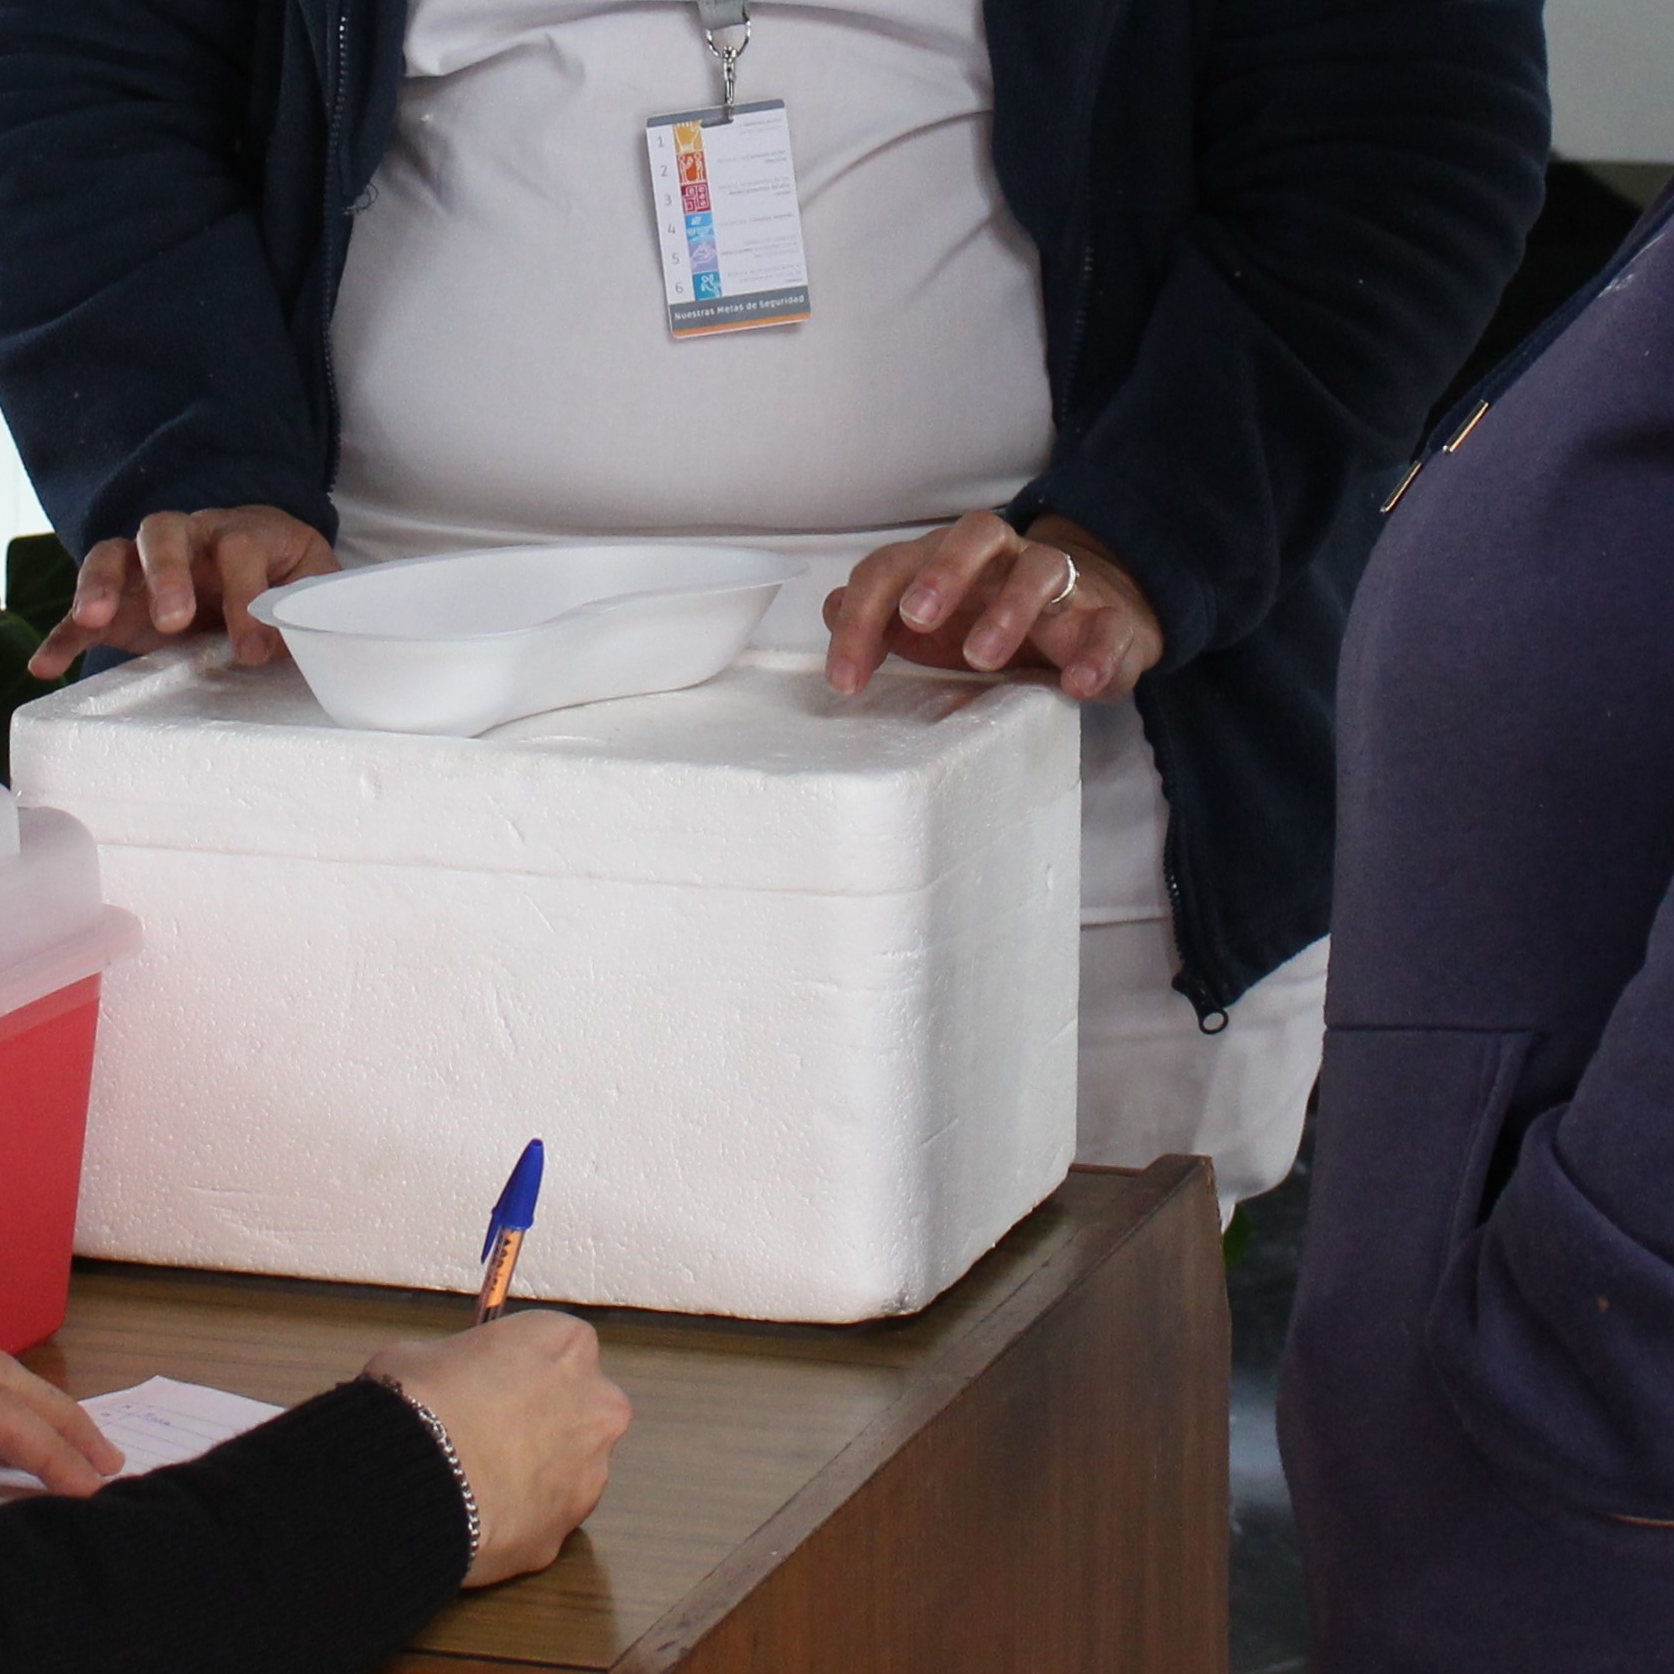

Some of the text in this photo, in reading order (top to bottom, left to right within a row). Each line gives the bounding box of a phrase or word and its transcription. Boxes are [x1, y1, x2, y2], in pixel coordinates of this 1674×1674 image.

[656, 135, 665, 148] 1
[660, 165, 669, 177] 2
[664, 193, 672, 206] 3
[667, 223, 676, 235] 4
[671, 254, 680, 266] 5
[675, 281, 684, 294] 6
[674, 294, 805, 321] Nuestras Metas de Seguridad
